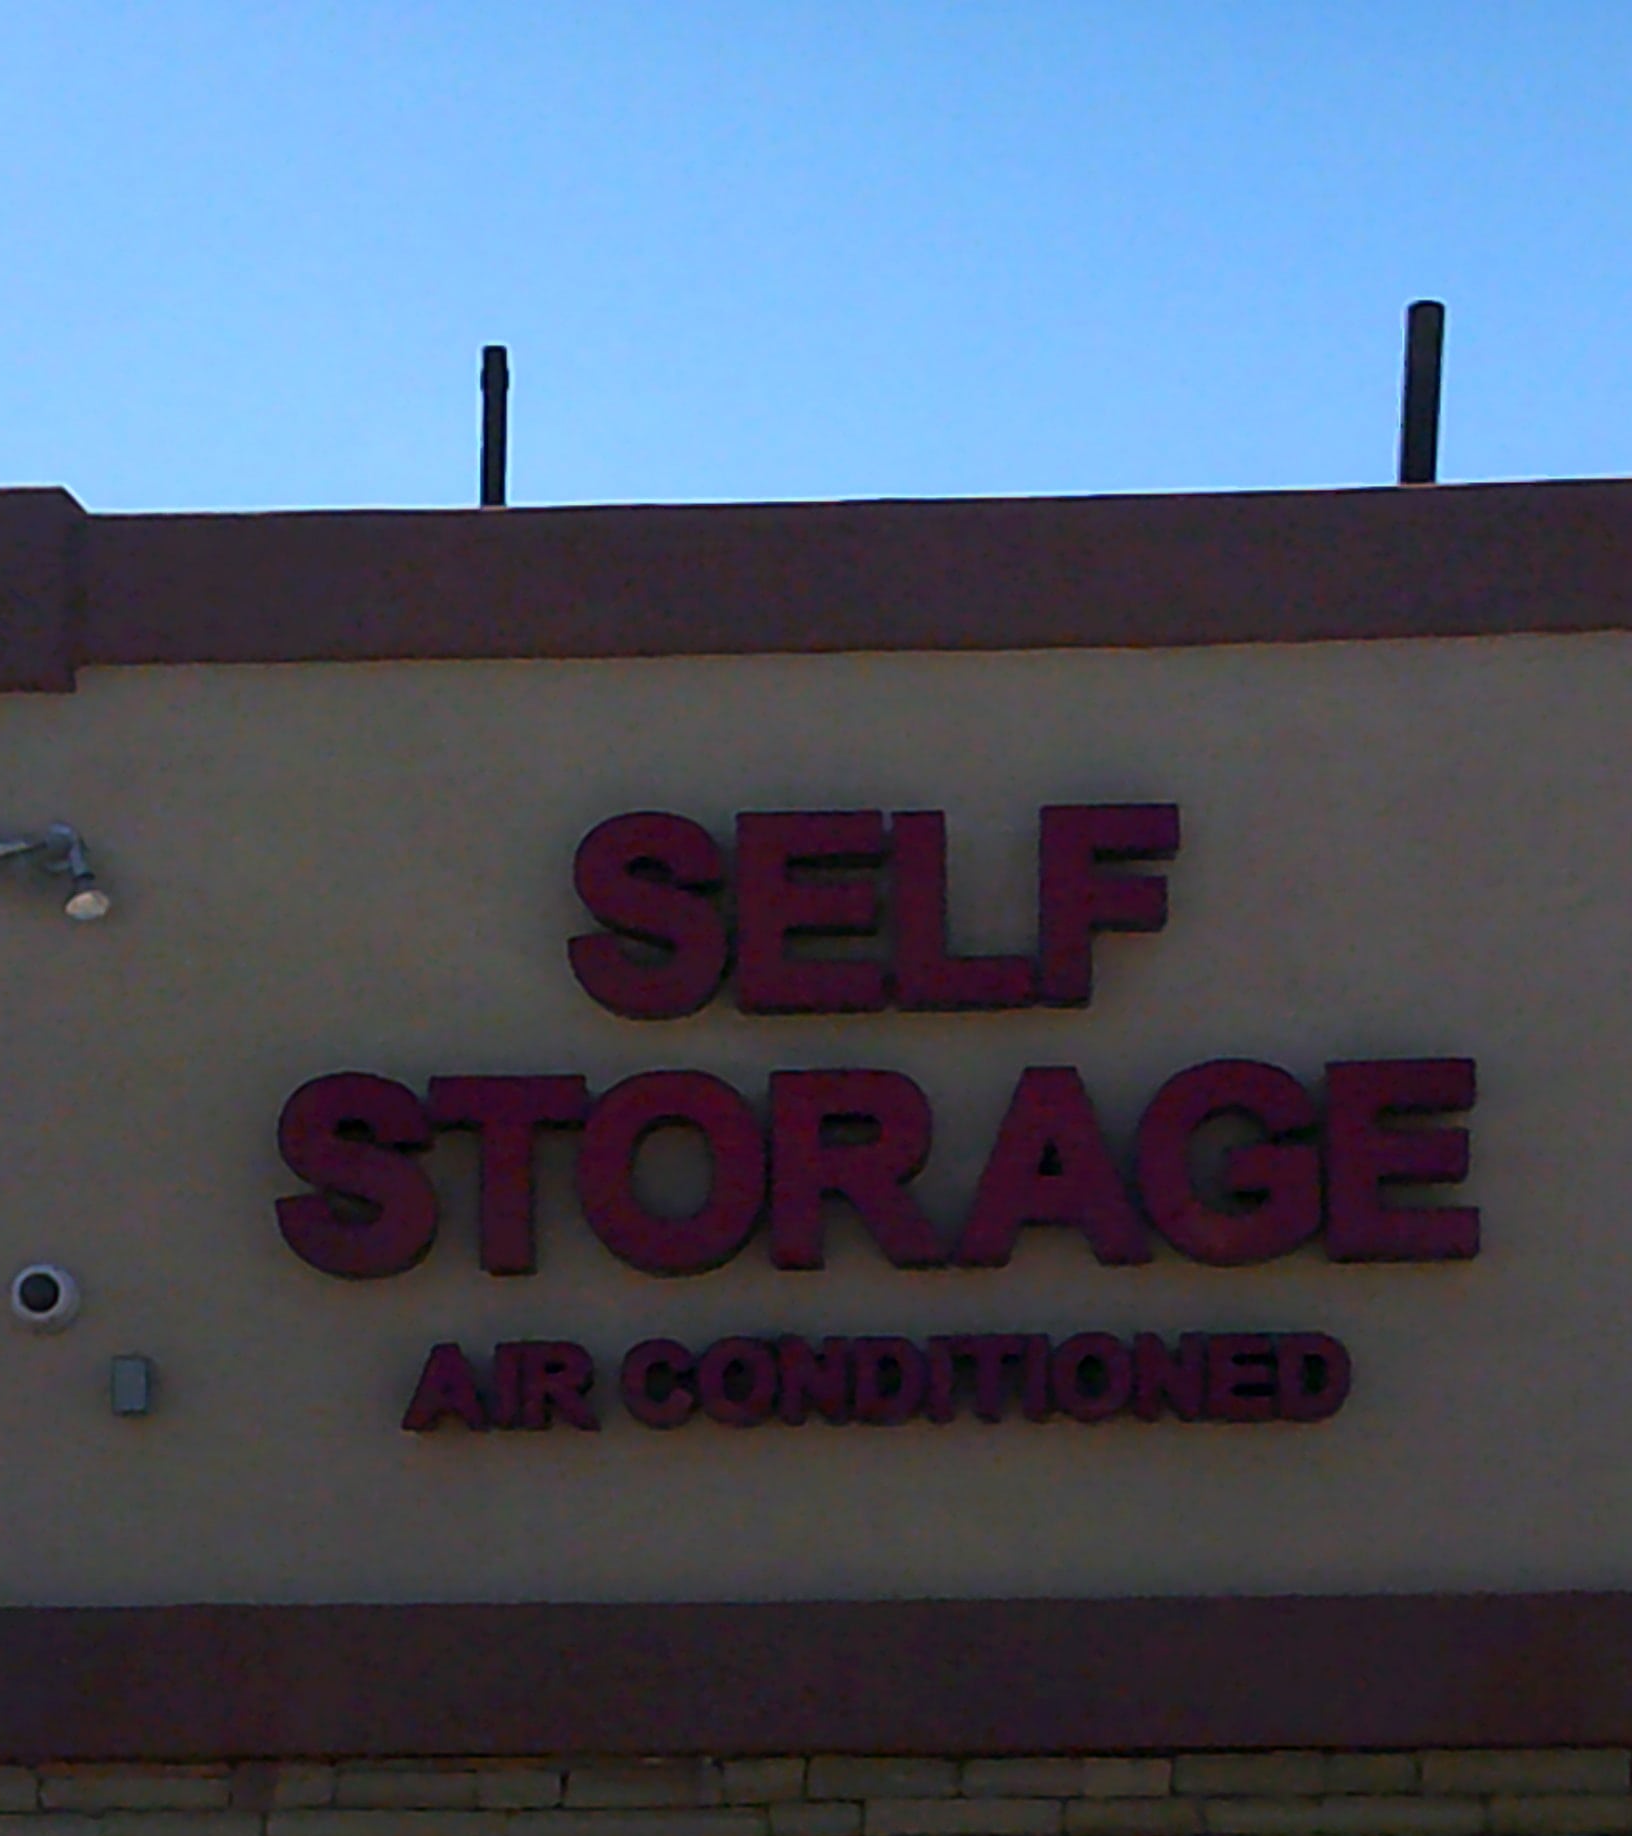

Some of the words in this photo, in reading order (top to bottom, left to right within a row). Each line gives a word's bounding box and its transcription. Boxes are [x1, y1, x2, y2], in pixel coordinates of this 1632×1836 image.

[567, 803, 1180, 1019] SELF
[274, 1057, 1481, 1279] STORAGE
[402, 1341, 600, 1432] AIR
[620, 1330, 1353, 1427] CONDITIONED
